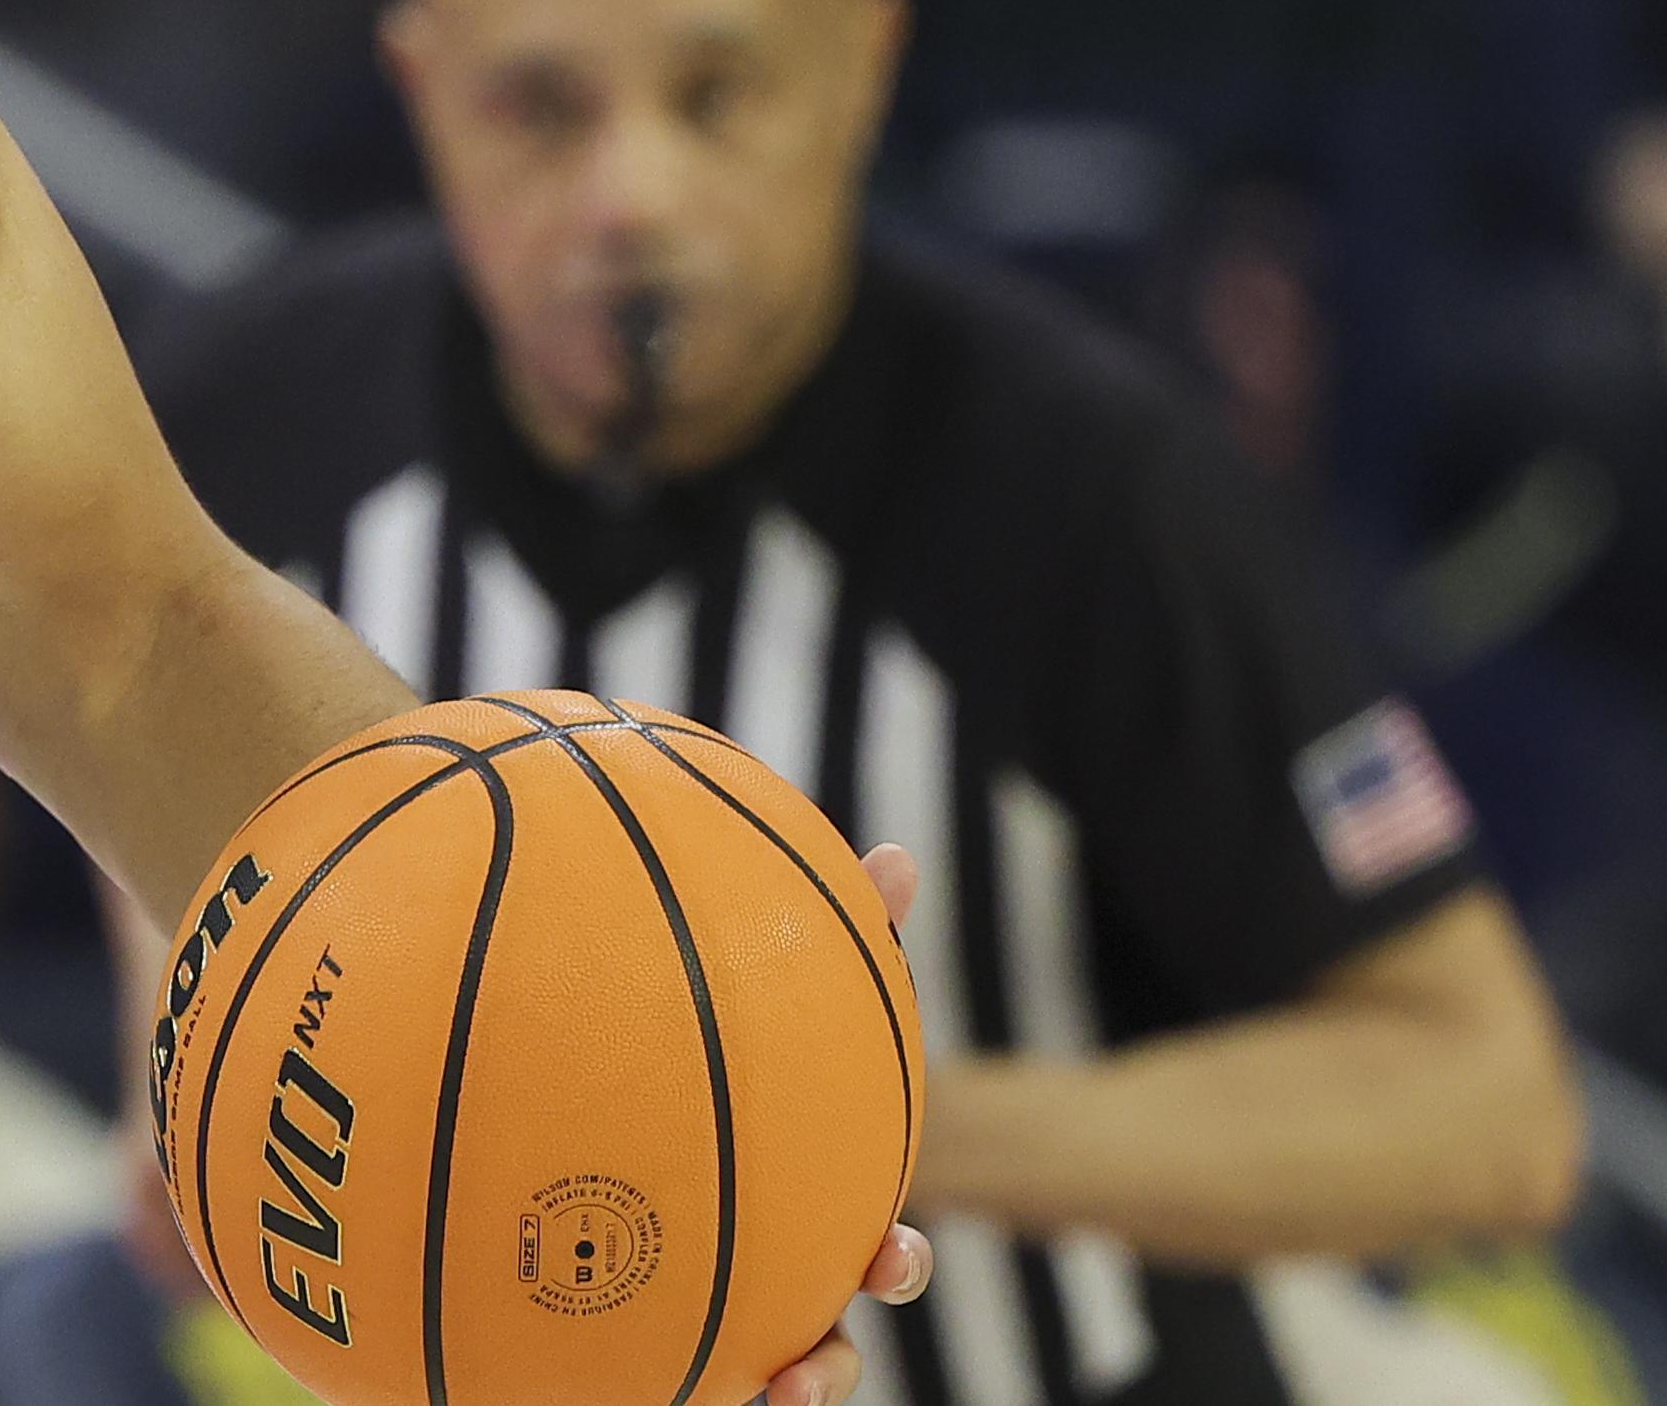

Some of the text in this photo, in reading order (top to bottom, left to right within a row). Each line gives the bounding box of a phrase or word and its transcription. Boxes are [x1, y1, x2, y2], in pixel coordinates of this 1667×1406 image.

[171, 1056, 185, 1122] GAME
[183, 994, 206, 1049] BALL
[258, 944, 355, 1349] EVO NXT
[522, 1218, 536, 1277] SIZE 7
